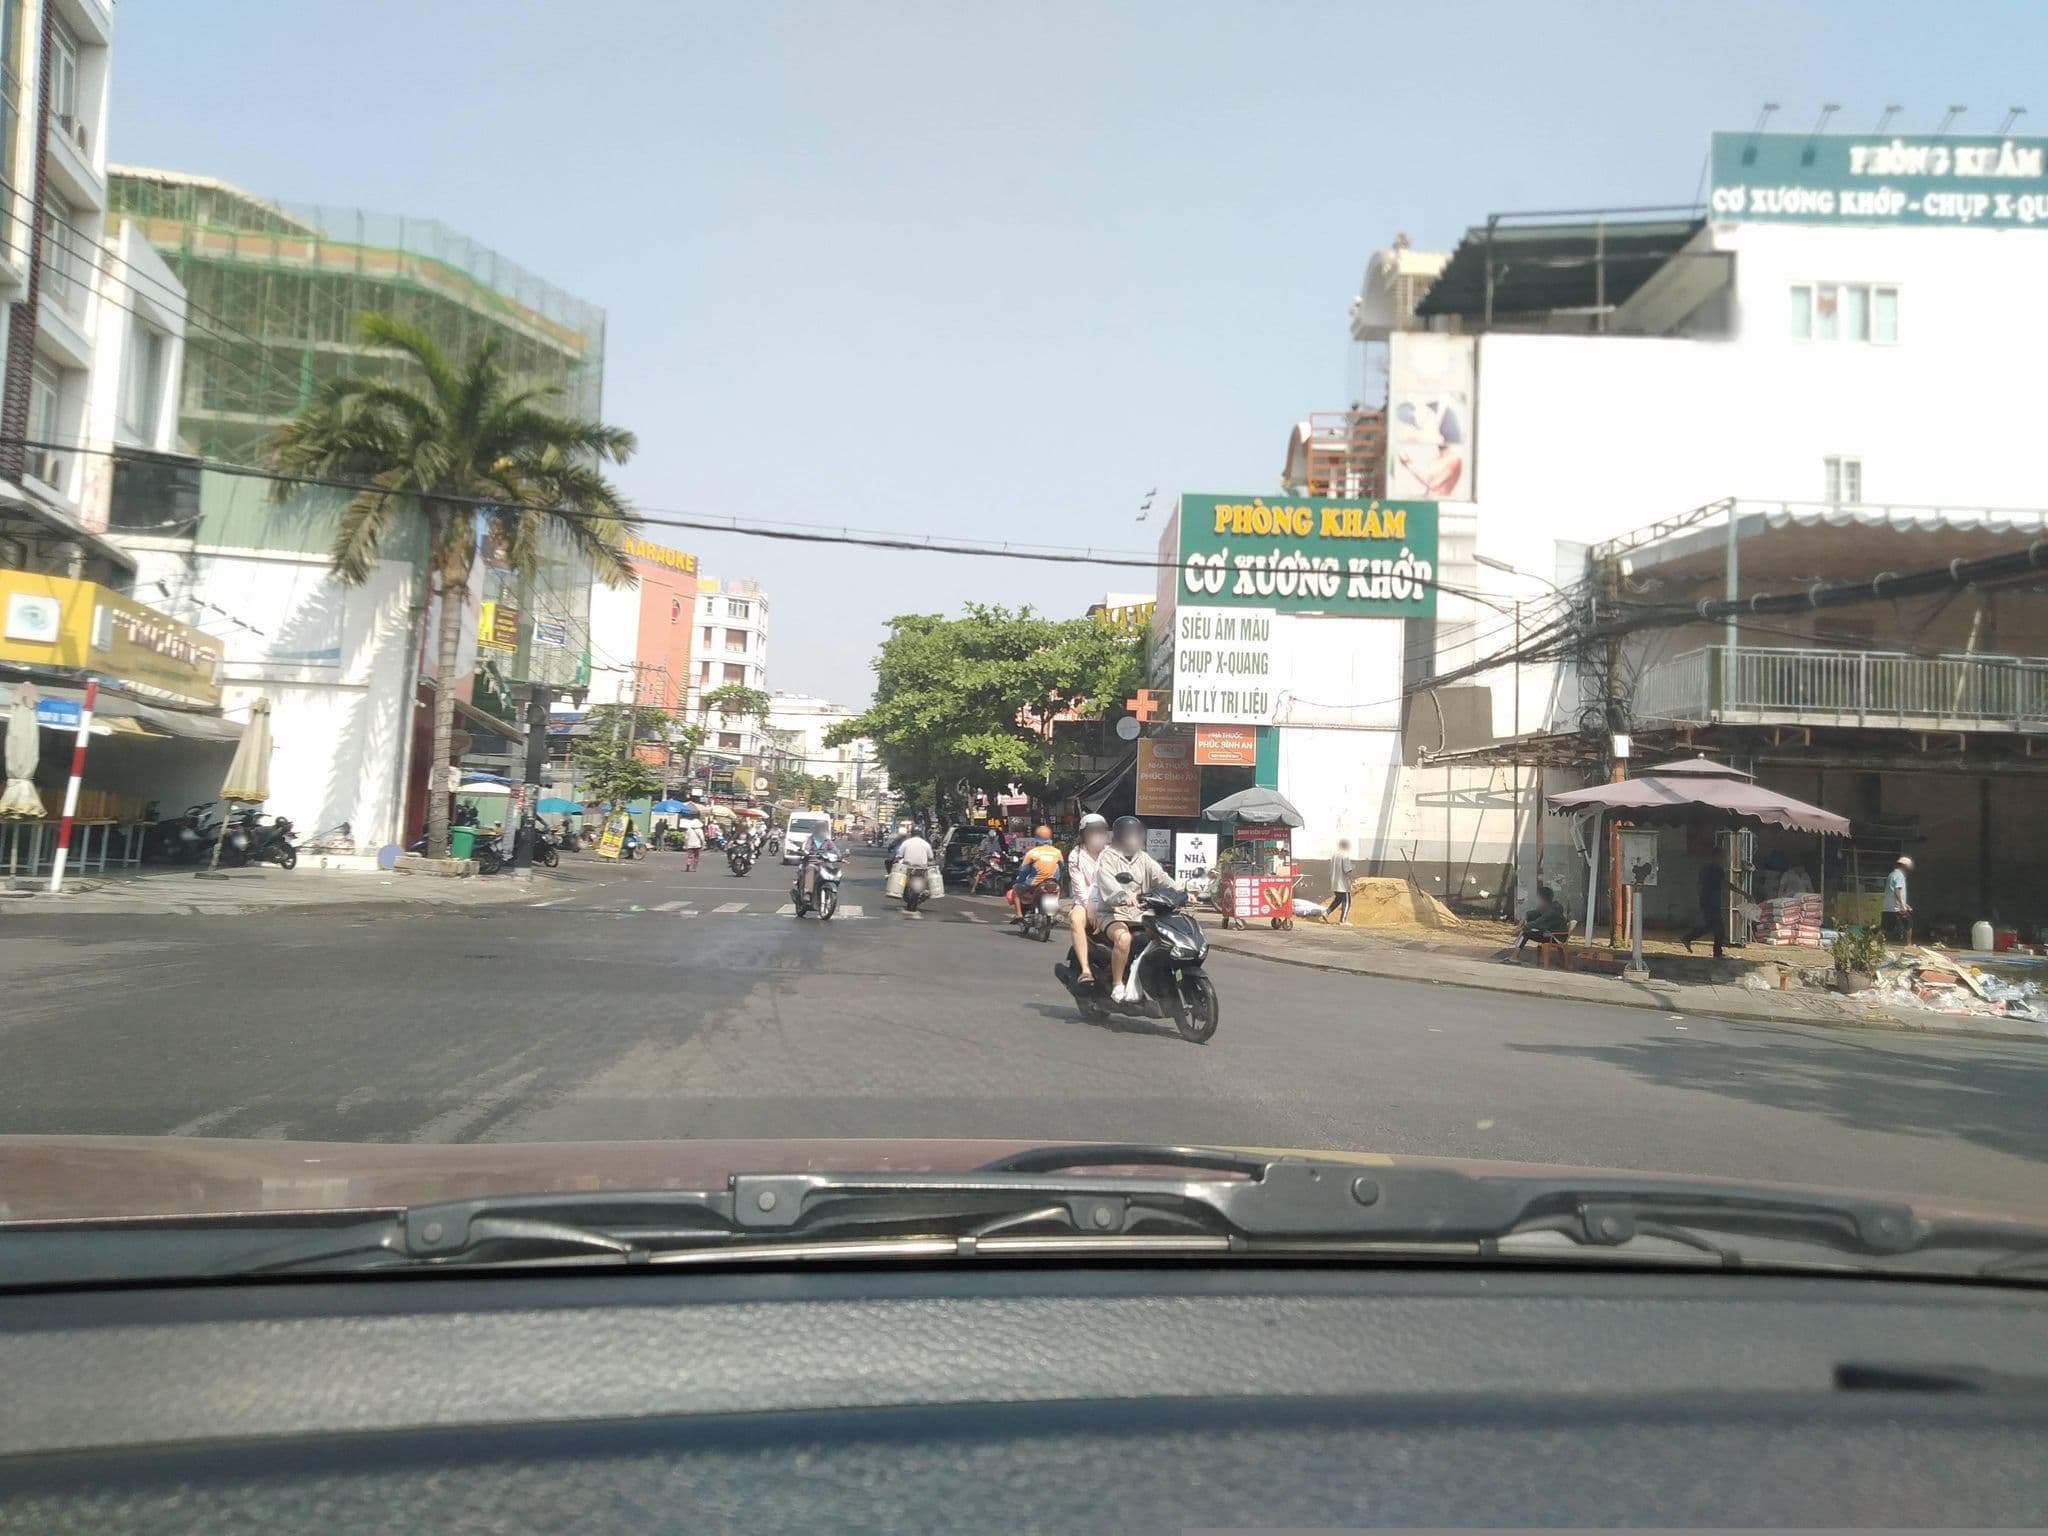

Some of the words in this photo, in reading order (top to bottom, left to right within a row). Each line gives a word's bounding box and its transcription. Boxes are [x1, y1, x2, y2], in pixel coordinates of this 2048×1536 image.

[1712, 184, 1745, 213] CƠ
[1750, 186, 1834, 215] XƯƠNG
[1923, 192, 1990, 223] CHỤP
[1214, 498, 1314, 537] PHÒNG
[1319, 500, 1406, 539] KHÁM
[624, 536, 695, 573] KARAOKE
[1184, 547, 1228, 593] CƠ
[1233, 548, 1341, 597] XƯƠNG
[1347, 547, 1432, 600] KHỚP
[1181, 612, 1211, 640] SIÊU
[1214, 612, 1236, 641] ÂM
[1240, 614, 1270, 642] MÀU
[1180, 650, 1212, 678] CHỤP
[1216, 651, 1269, 677] X-QUANG
[1179, 685, 1200, 717] VẬT
[1203, 686, 1217, 713] LÝ
[1221, 690, 1239, 719] TRỊ
[1242, 687, 1268, 720] LIỆU
[1241, 741, 1253, 749] AN
[1184, 852, 1206, 863] NHÀ
